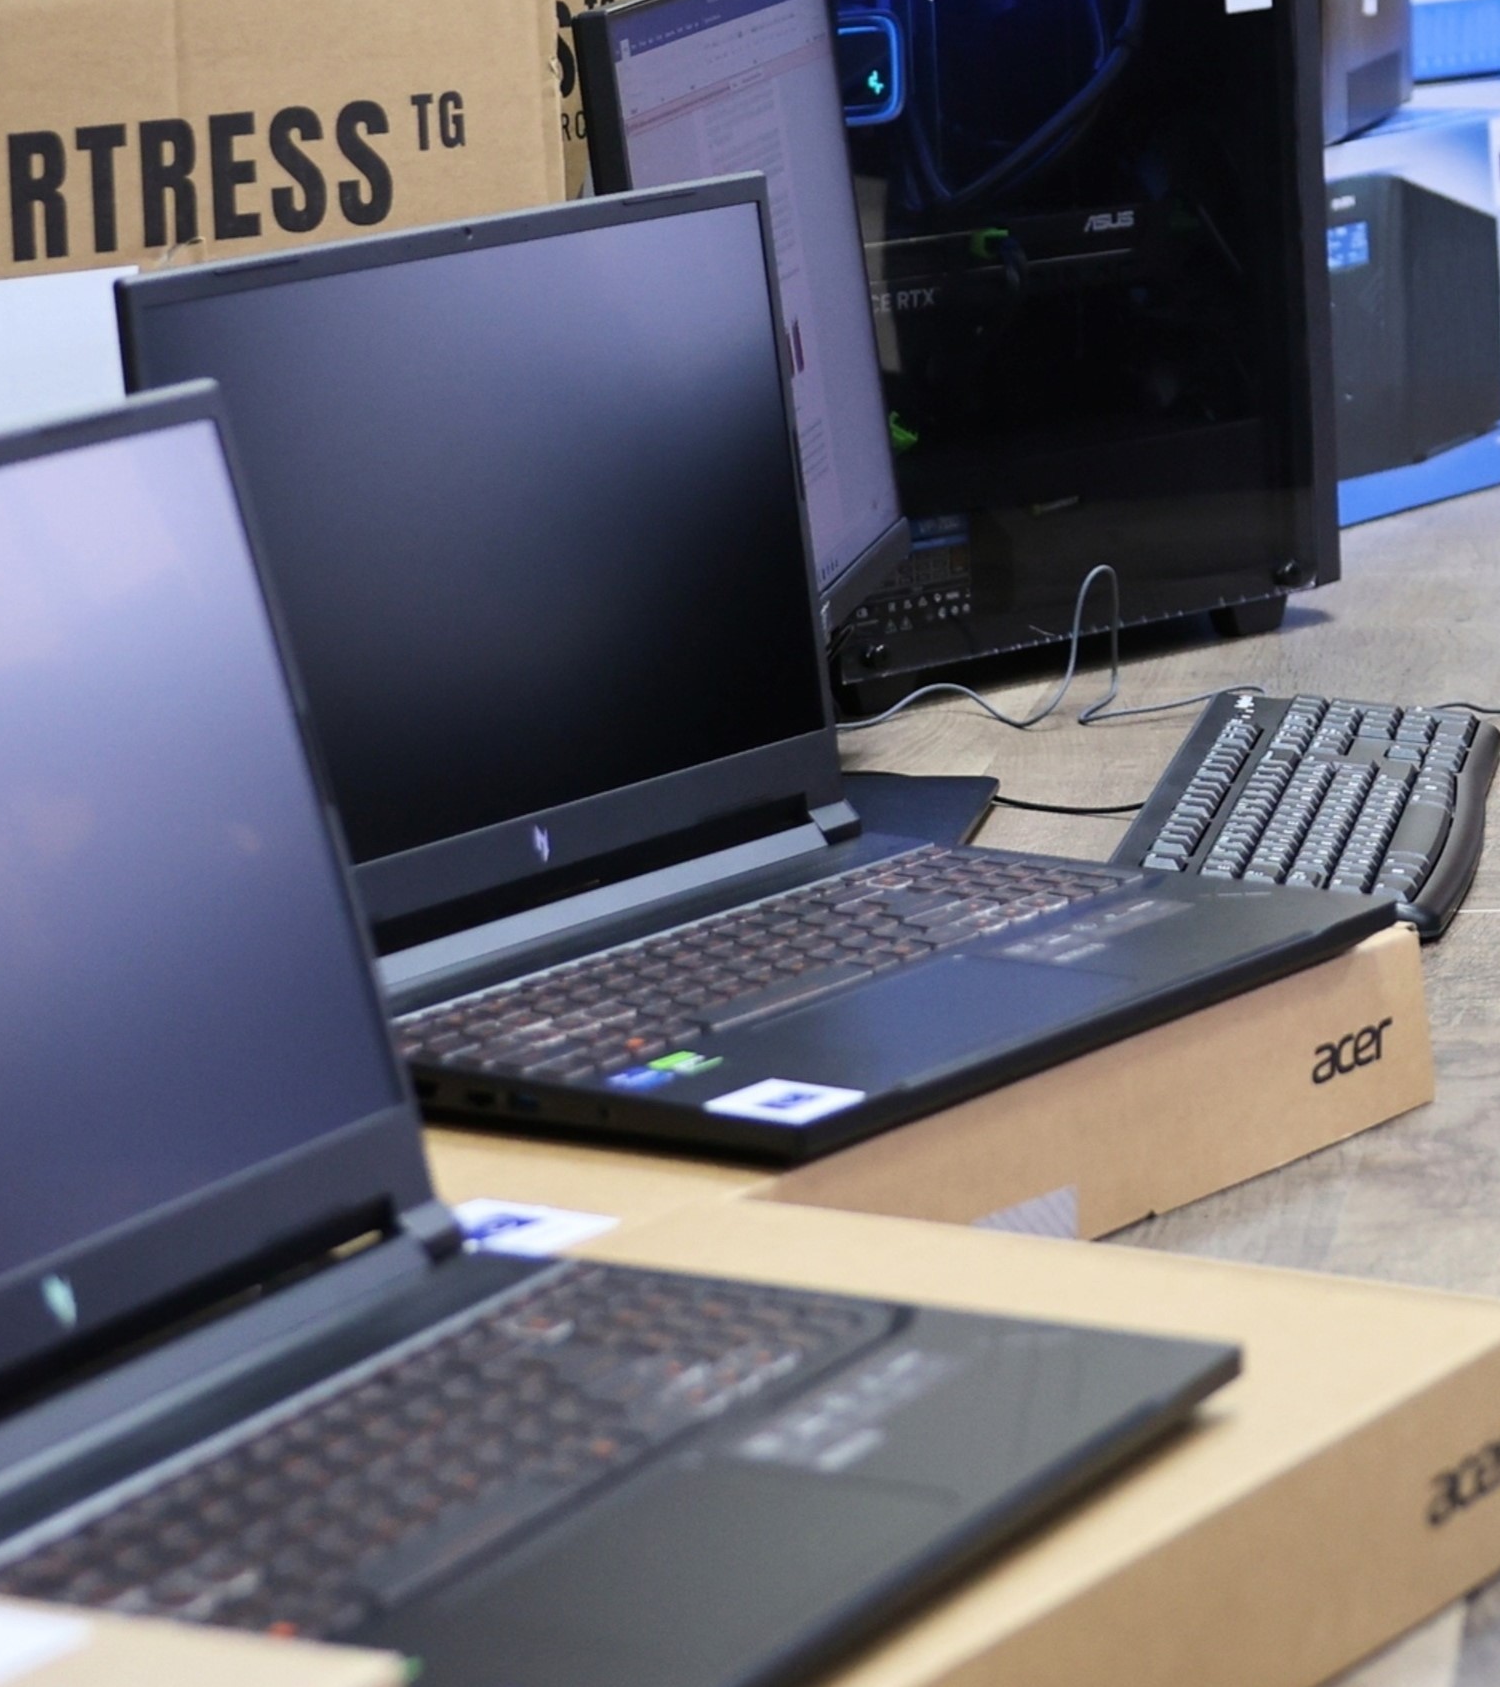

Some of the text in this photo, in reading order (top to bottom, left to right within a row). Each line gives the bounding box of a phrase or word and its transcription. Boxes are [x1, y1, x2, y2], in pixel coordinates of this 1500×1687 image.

[410, 90, 467, 152] TG
[1083, 210, 1135, 233] ASUS
[897, 288, 935, 310] RTX
[1312, 1016, 1393, 1084] acer
